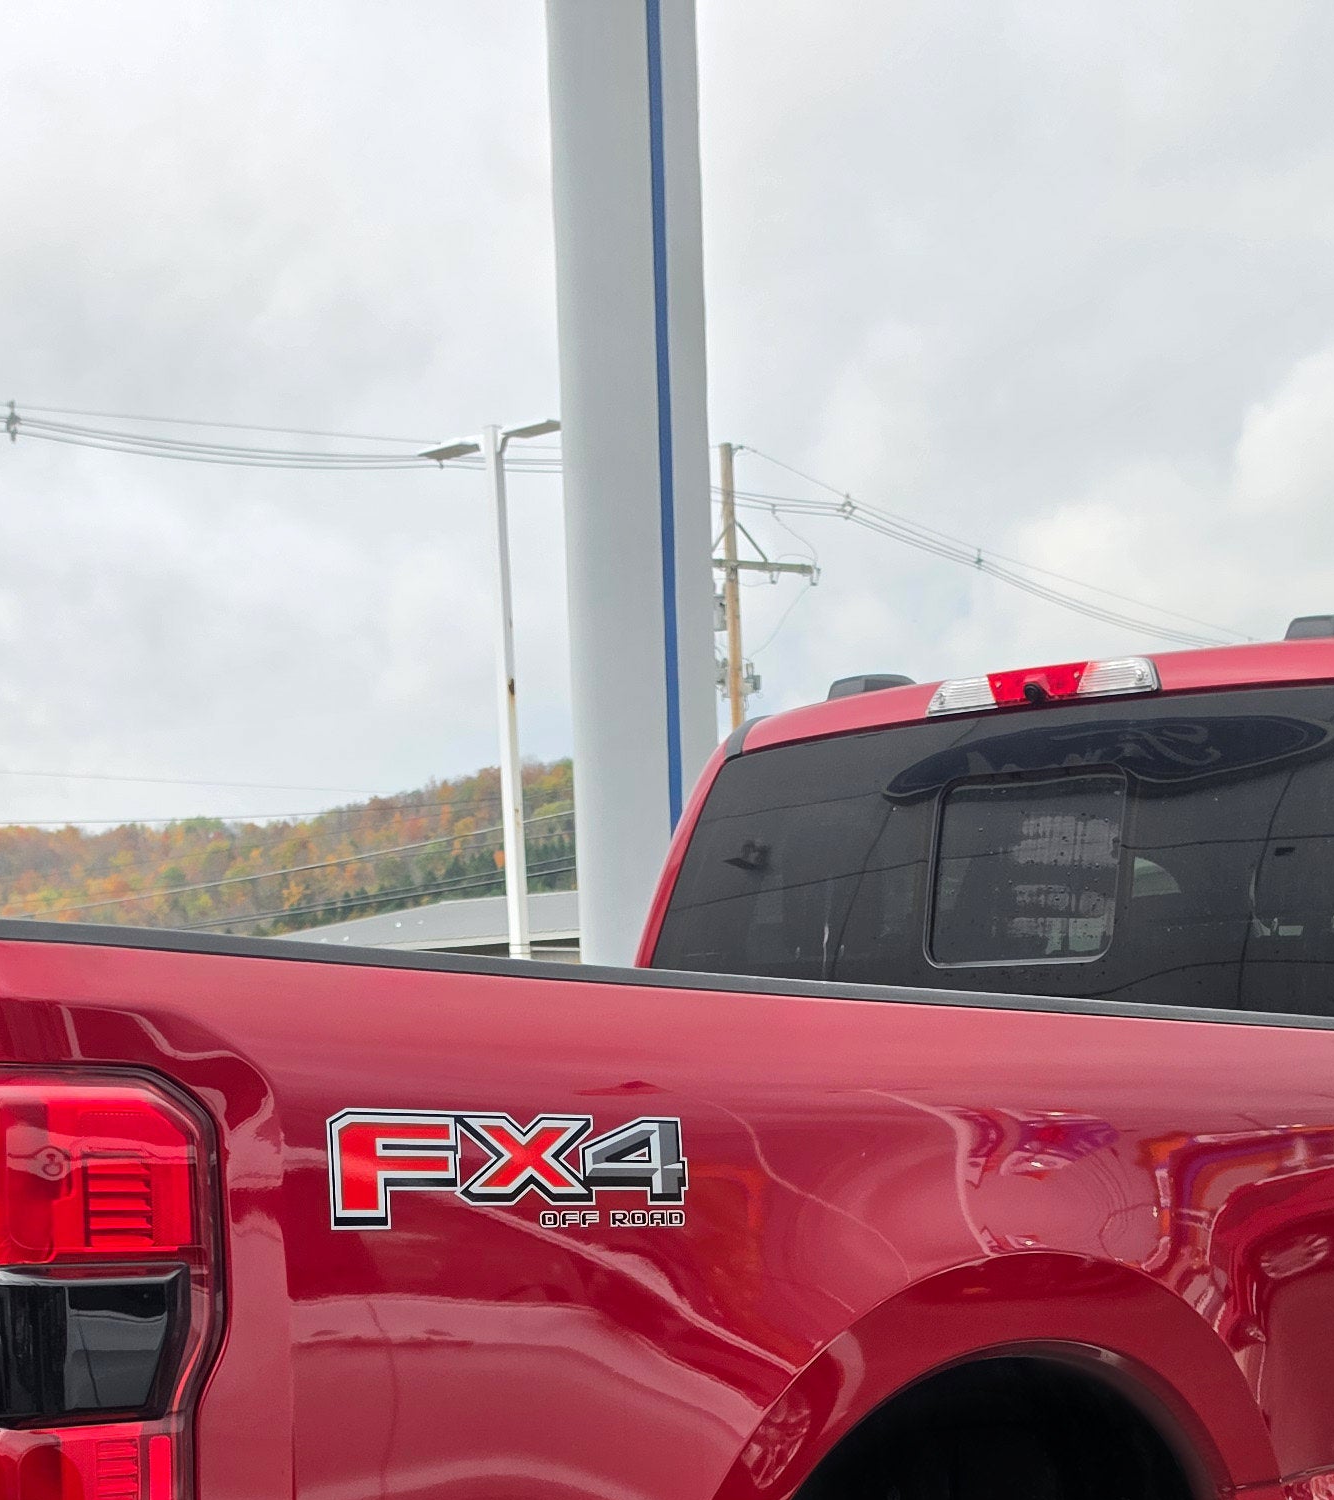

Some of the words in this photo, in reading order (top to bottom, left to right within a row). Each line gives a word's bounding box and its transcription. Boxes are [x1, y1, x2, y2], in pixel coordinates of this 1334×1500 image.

[326, 1108, 689, 1230] FX4
[539, 1210, 600, 1228] OFF
[609, 1209, 686, 1228] ROAD
